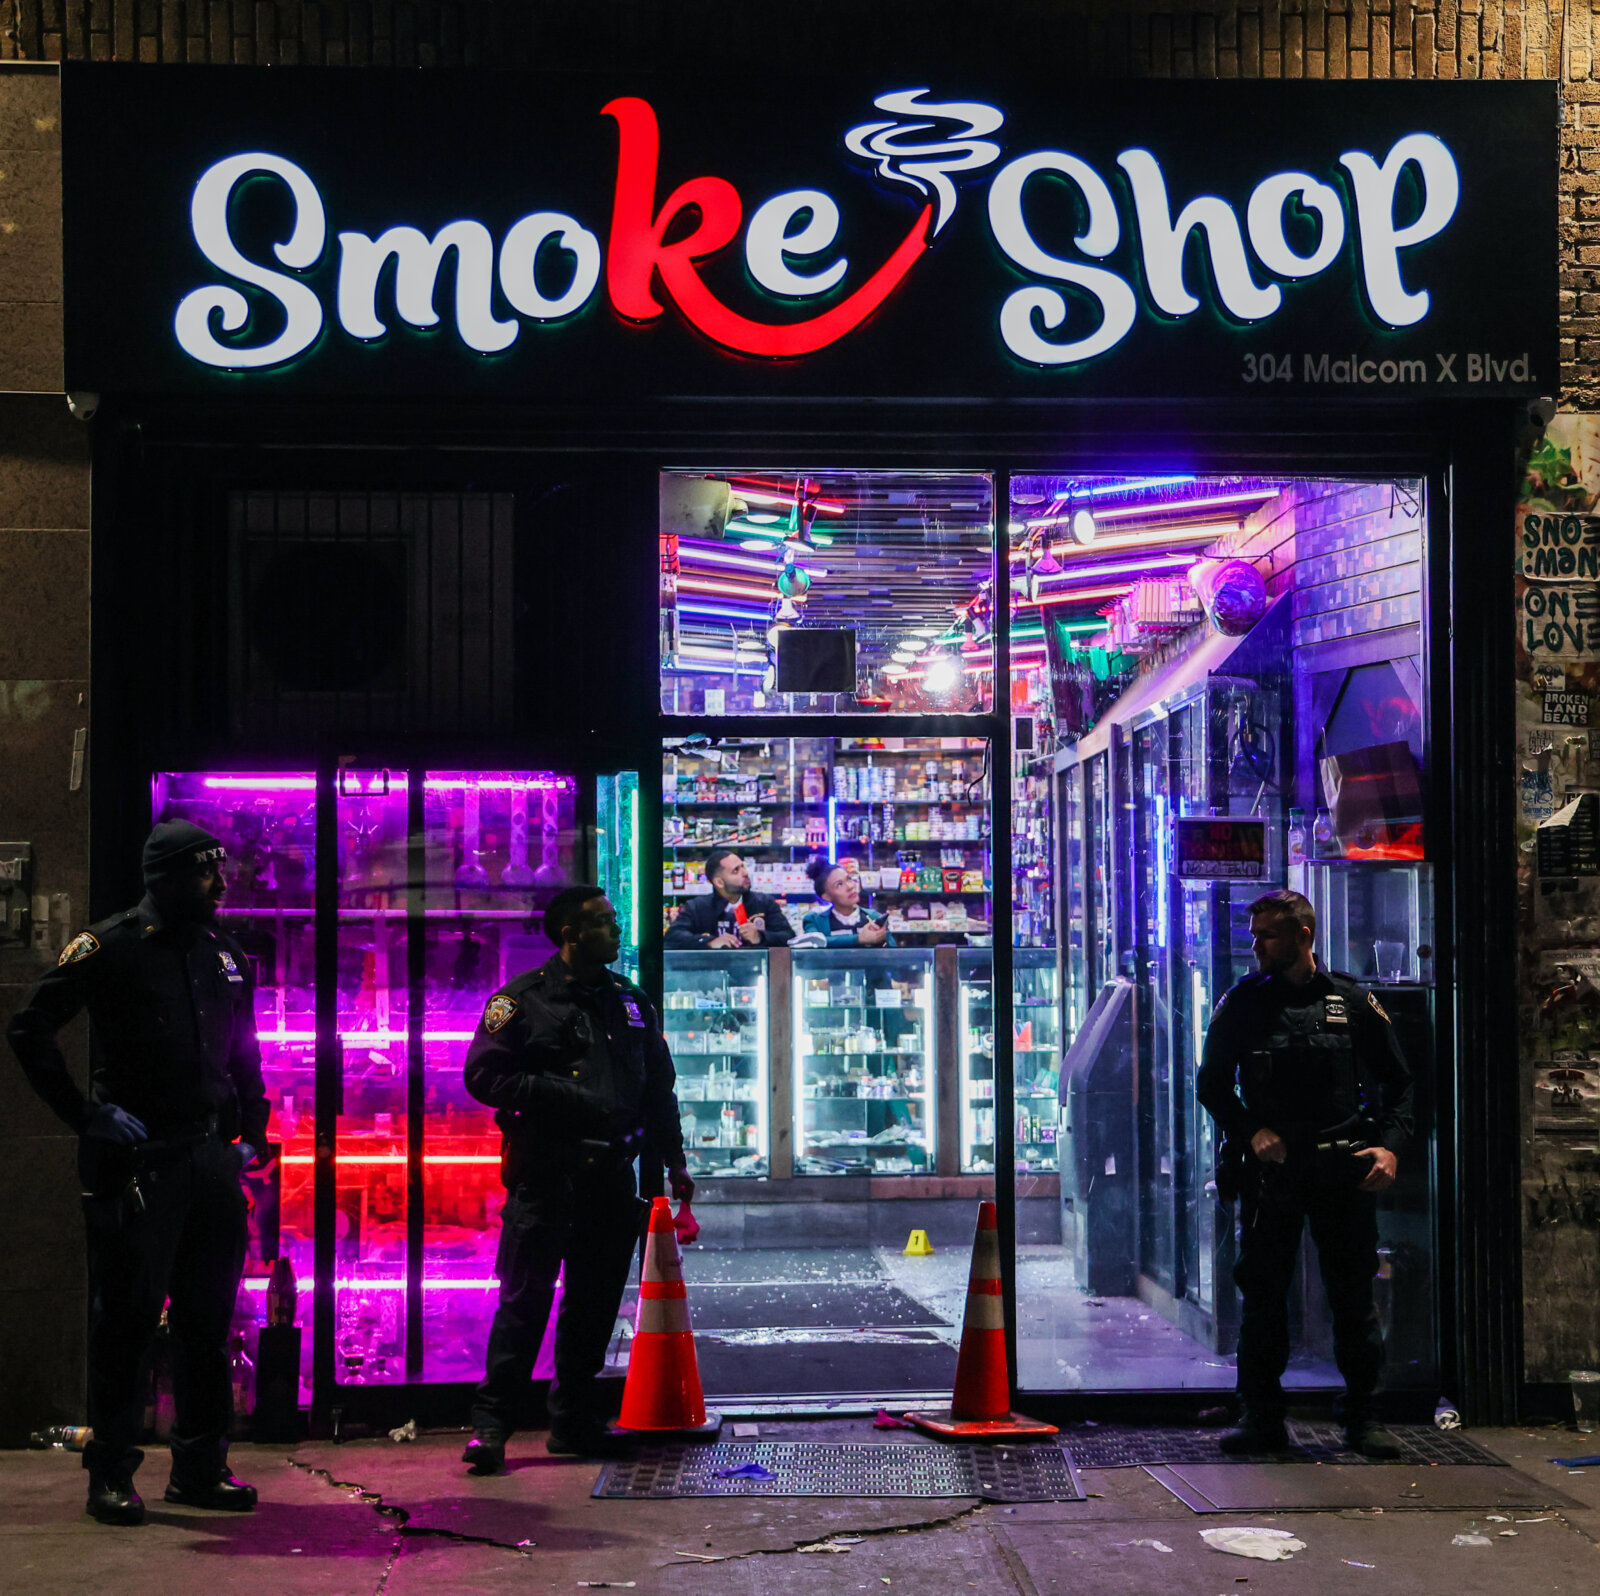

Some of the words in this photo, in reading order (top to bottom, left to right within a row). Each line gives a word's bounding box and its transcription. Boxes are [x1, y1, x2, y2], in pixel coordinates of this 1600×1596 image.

[174, 96, 932, 369] Smoke
[987, 131, 1461, 366] Shop
[1241, 353, 1294, 383] 304
[1303, 353, 1427, 384] Malcom
[1435, 353, 1457, 382] X
[1466, 352, 1537, 383] Blvd.
[1525, 587, 1600, 618] ONE
[1544, 692, 1589, 705] BROKEN
[1544, 703, 1588, 714] LAND
[1543, 713, 1588, 724] BEATS
[194, 848, 228, 863] NYP
[914, 1235, 919, 1246] 1
